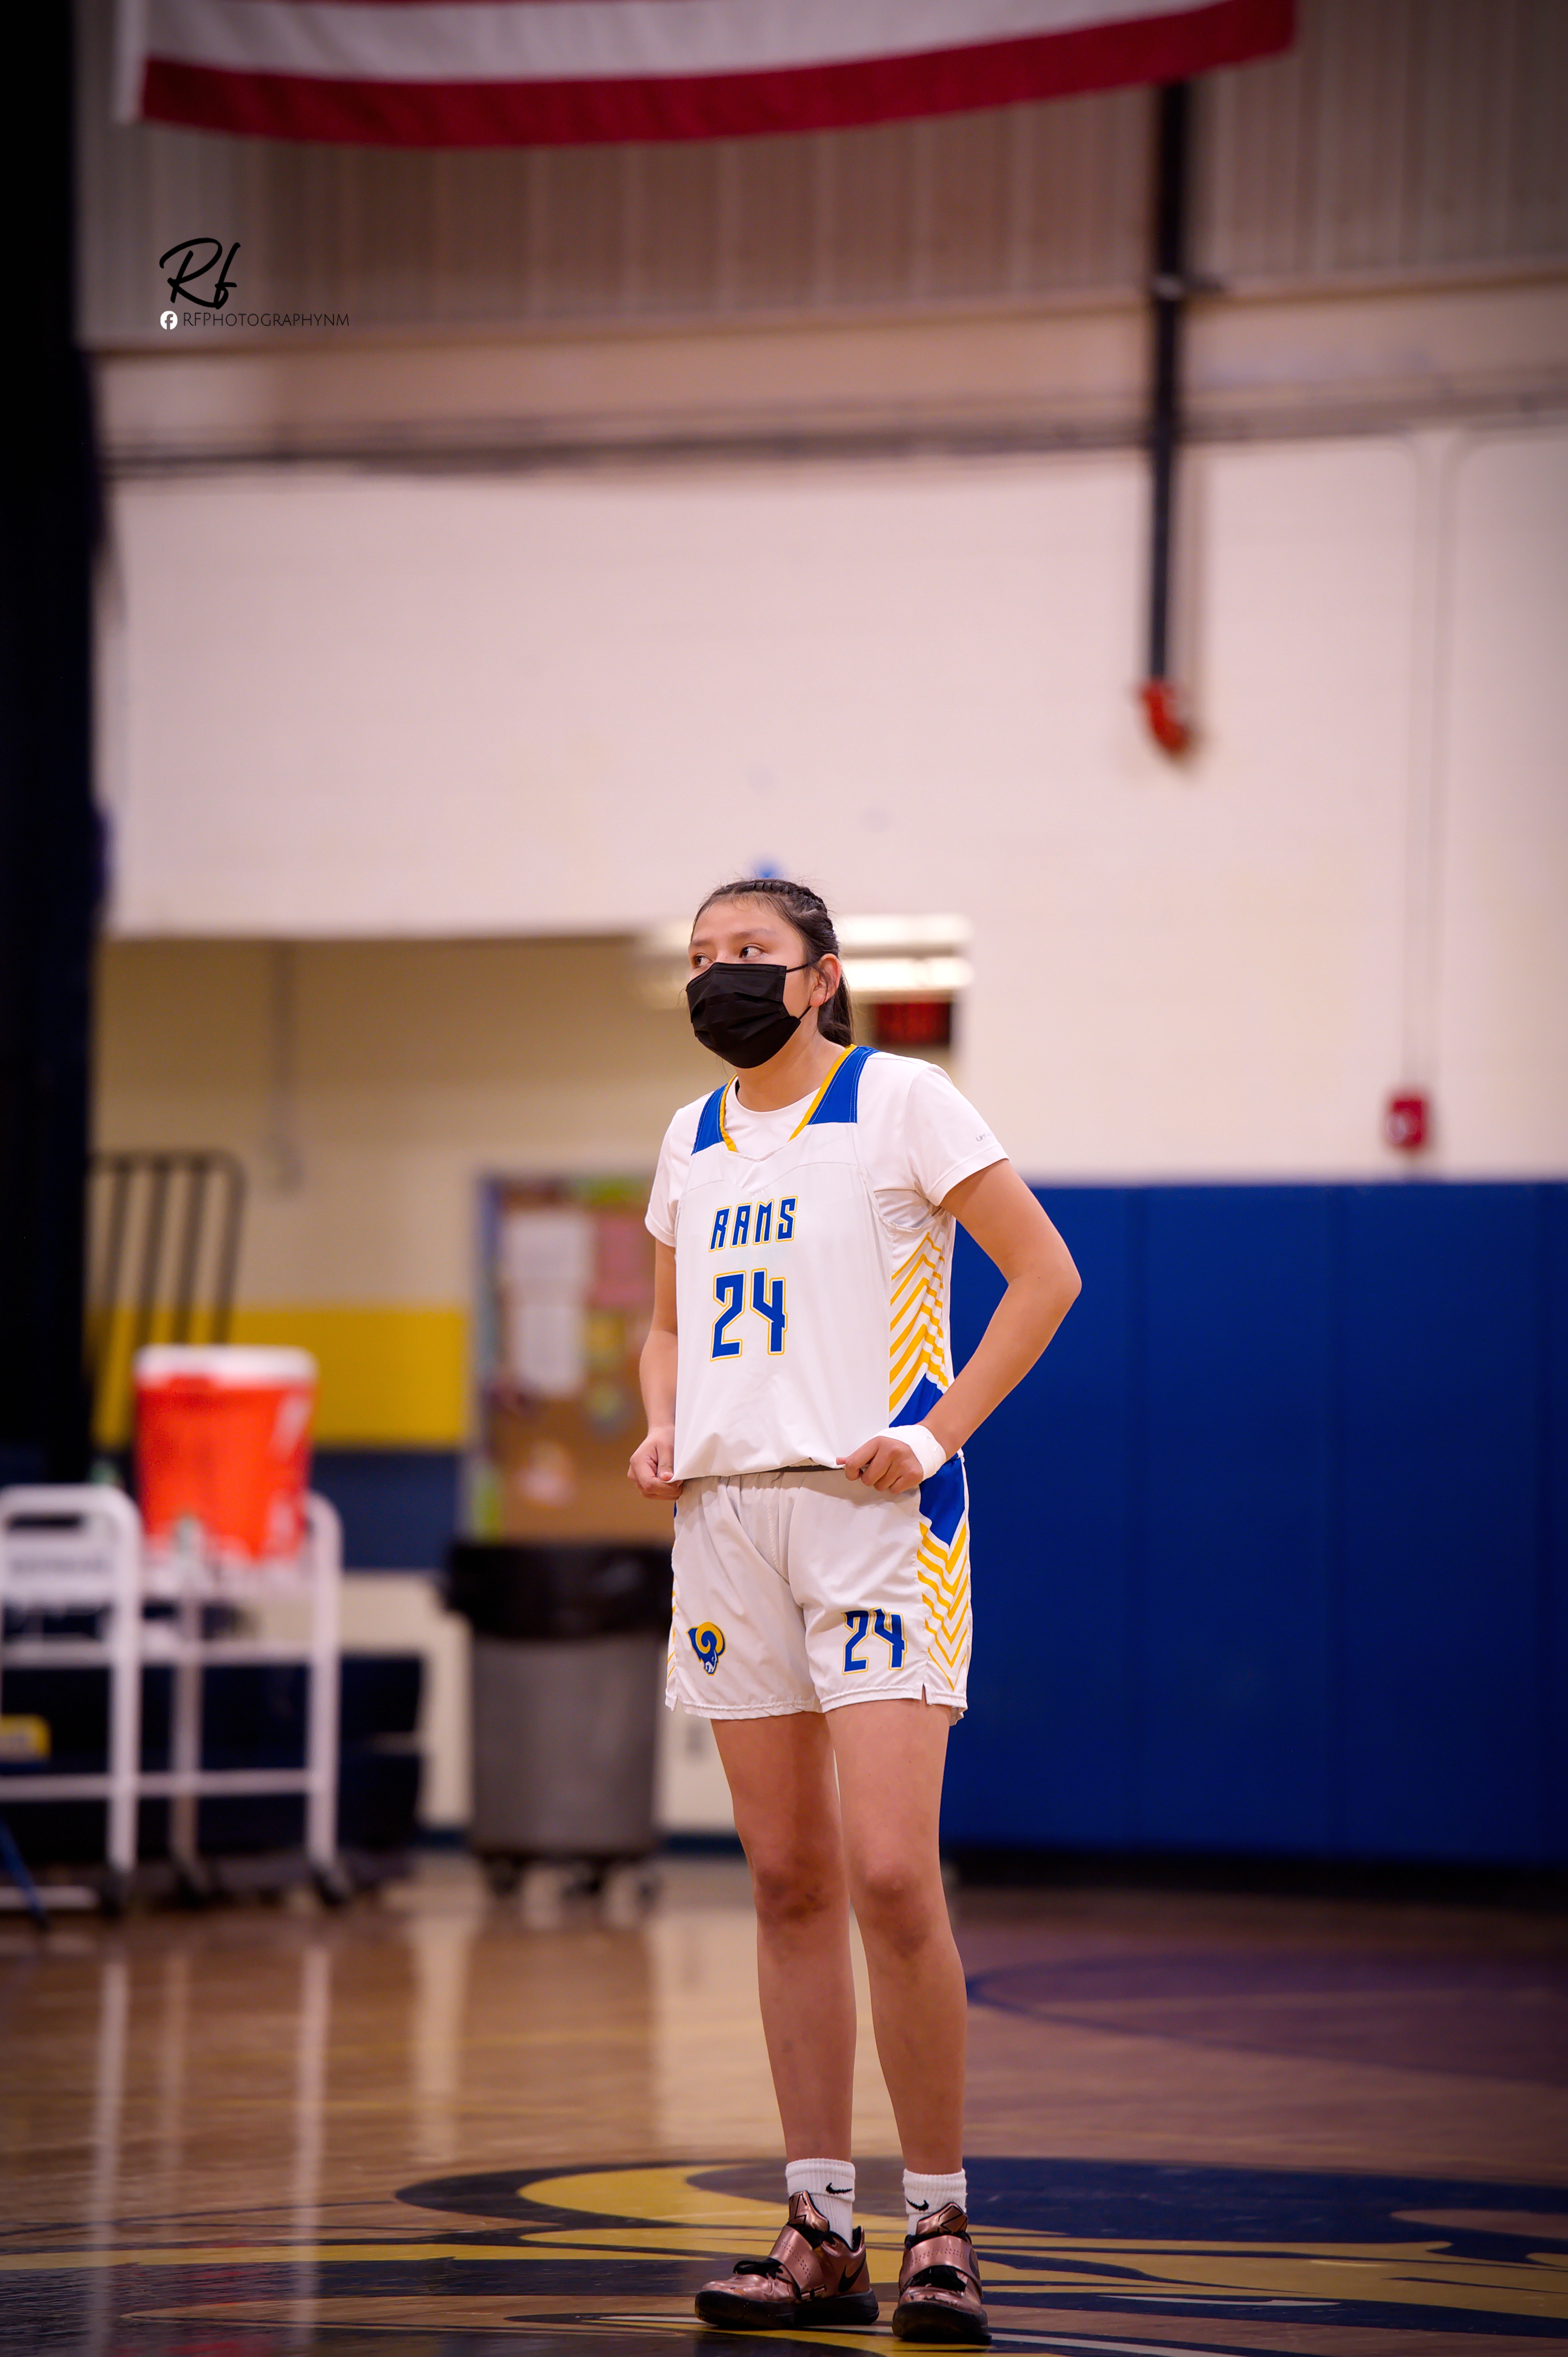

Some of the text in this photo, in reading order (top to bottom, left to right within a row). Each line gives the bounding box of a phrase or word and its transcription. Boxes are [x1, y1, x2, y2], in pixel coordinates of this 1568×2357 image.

[708, 1196, 798, 1252] RAMS
[710, 1268, 788, 1362] 24
[842, 1607, 907, 1675] 24
